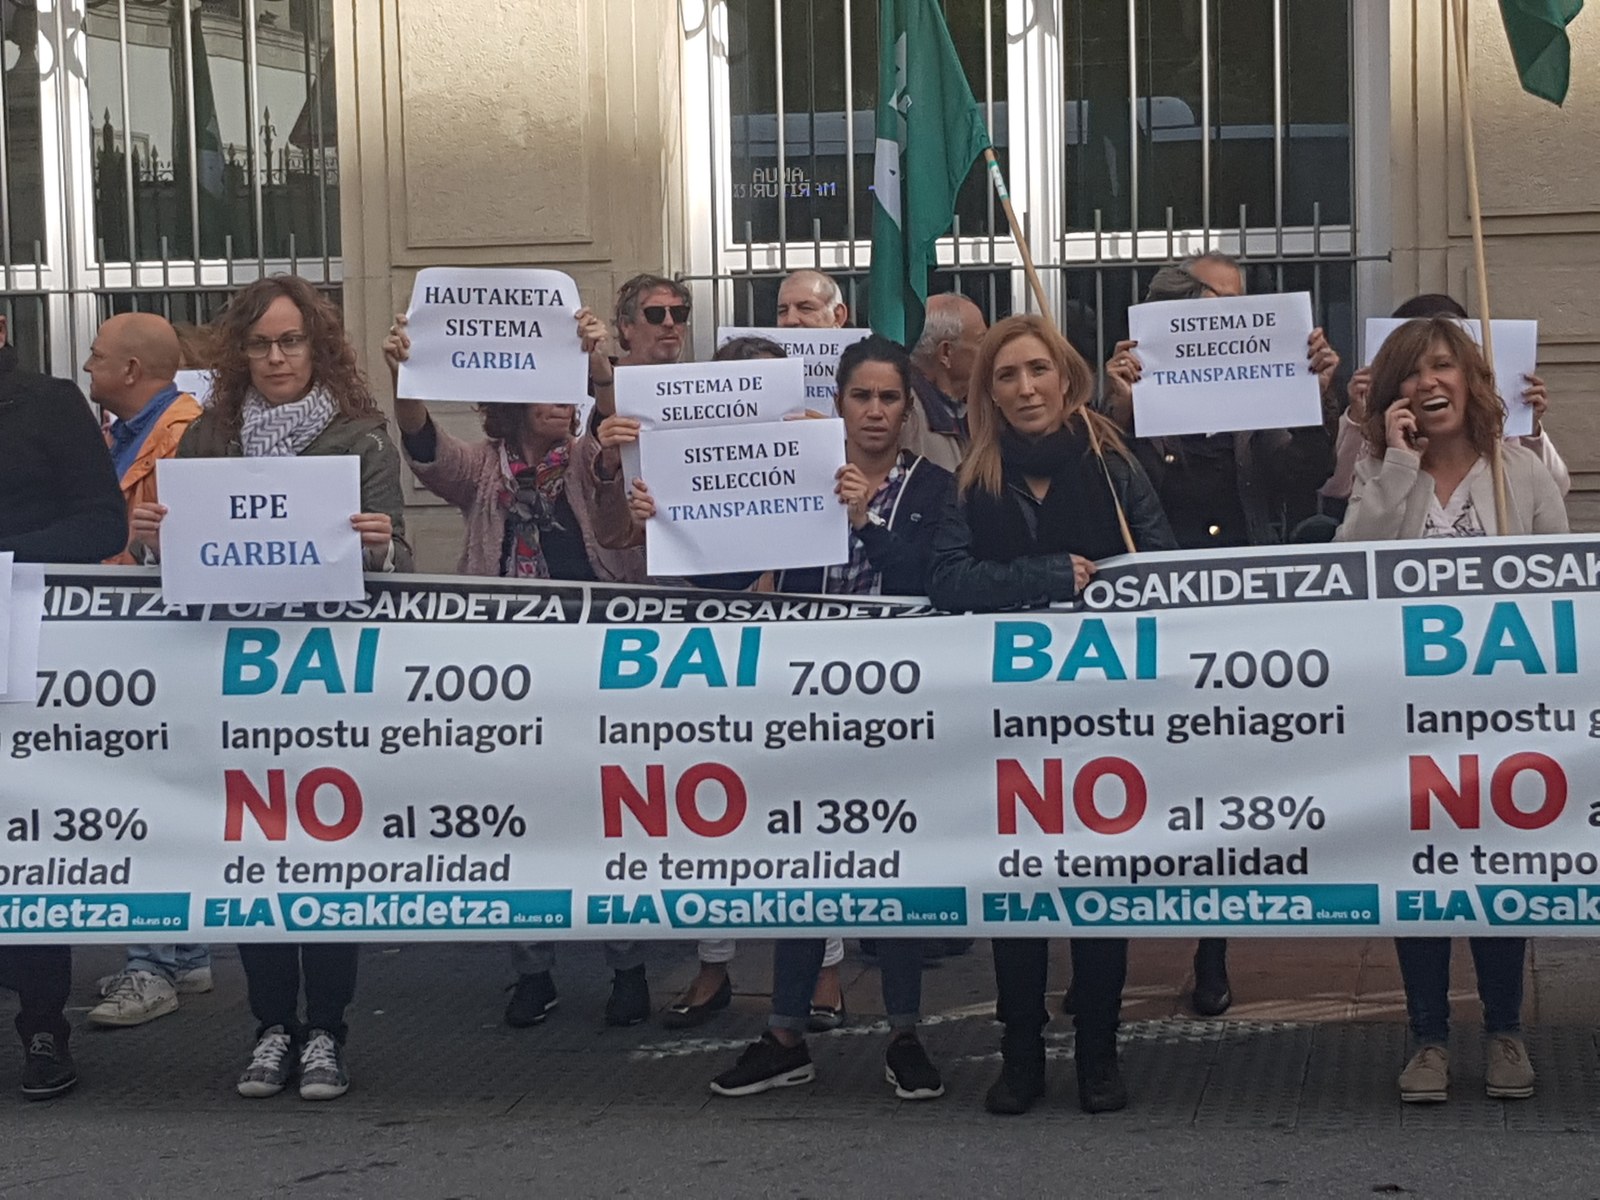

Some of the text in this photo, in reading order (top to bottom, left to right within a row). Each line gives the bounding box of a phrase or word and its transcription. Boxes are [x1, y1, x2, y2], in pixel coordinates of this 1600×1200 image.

[424, 286, 564, 306] HAUTAKETA
[445, 318, 543, 338] SISTEMA
[1170, 312, 1276, 333] SISTEMA DE
[451, 351, 536, 370] GARBIA
[819, 343, 839, 356] DE
[1175, 335, 1271, 358] SELECCIÓN
[656, 376, 763, 397] SISTEMA DE
[1153, 362, 1296, 386] TRANSPARENTE
[662, 400, 758, 422] SELECCIÓN
[684, 441, 799, 464] SISTEMA DE
[692, 467, 796, 492] SELECCIÓN
[230, 494, 287, 520] EPE
[668, 495, 824, 522] TRANSPARENTE
[200, 541, 321, 567] GARBIA
[1083, 563, 1353, 609] OSAKIDETZA
[1393, 557, 1483, 593] OPE
[605, 596, 687, 622] OPE
[992, 617, 1329, 689] BAI 7.000
[1402, 600, 1578, 676] BAI
[222, 627, 531, 702] BAI 7.000
[599, 626, 921, 696] BAI 7.000
[36, 669, 156, 708] 7.000
[222, 717, 543, 756] lanpostu gehiagori
[599, 711, 935, 750] lanpostu gehiagori
[993, 705, 1345, 744] lanpostu gehiagori
[1406, 703, 1576, 740] lanpostu
[10, 723, 169, 759] gehiagori
[224, 766, 527, 842] NO al 38%
[600, 762, 918, 838] NO al 38%
[996, 756, 1326, 835] NO al 38%
[1409, 752, 1568, 831] NO
[6, 807, 148, 842] al 38%
[224, 853, 511, 890] de temporalidad
[605, 850, 901, 886] de temporalidad
[1000, 847, 1309, 884] de temporalidad
[1412, 844, 1599, 882] de tempo
[203, 898, 276, 927] ELA
[290, 893, 510, 928] Osakidetza
[587, 894, 661, 924] ELA
[674, 891, 904, 925] Osakidetza
[982, 892, 1061, 922] ELA
[1074, 888, 1313, 922] Osakidetza
[1396, 890, 1478, 921] ELA
